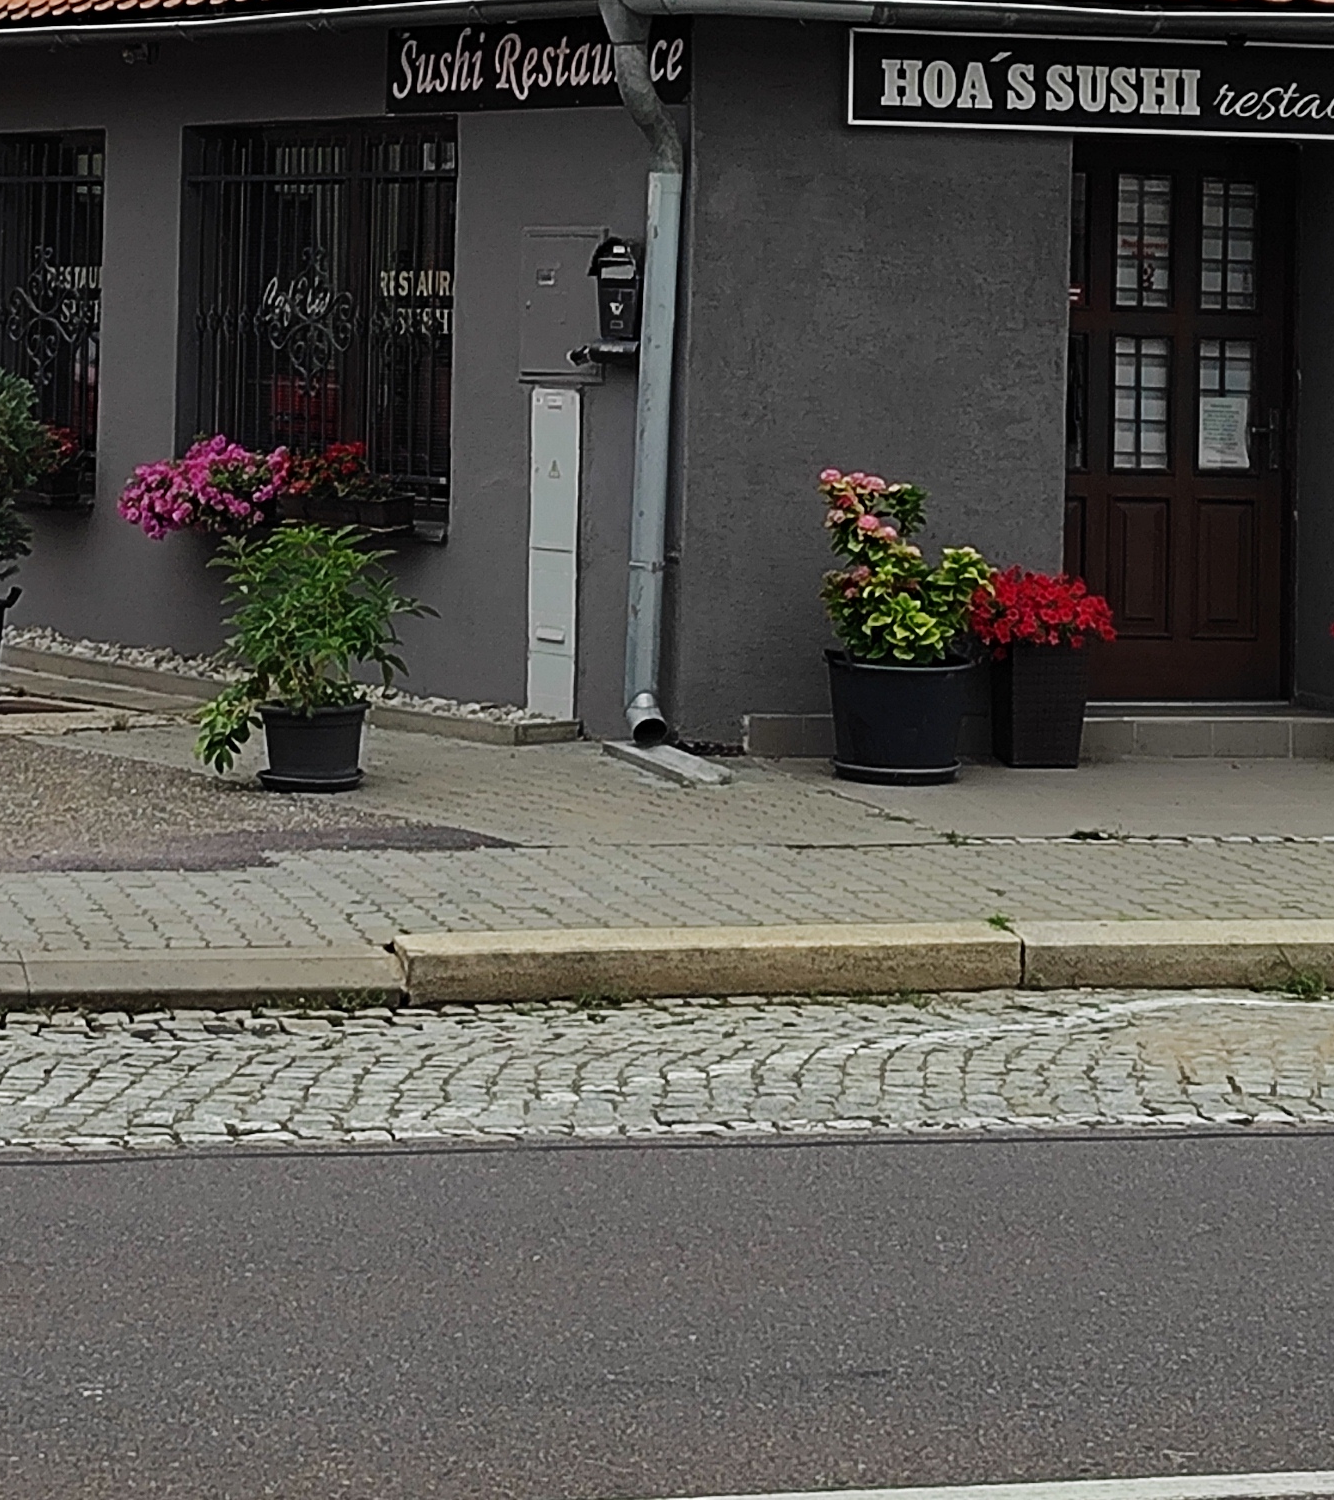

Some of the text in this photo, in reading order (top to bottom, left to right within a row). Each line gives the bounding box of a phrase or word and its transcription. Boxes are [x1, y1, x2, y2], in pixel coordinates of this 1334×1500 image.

[393, 28, 684, 101] Sushi Restauce
[1046, 65, 1201, 116] SUSHI
[380, 270, 455, 297] RESTAUR
